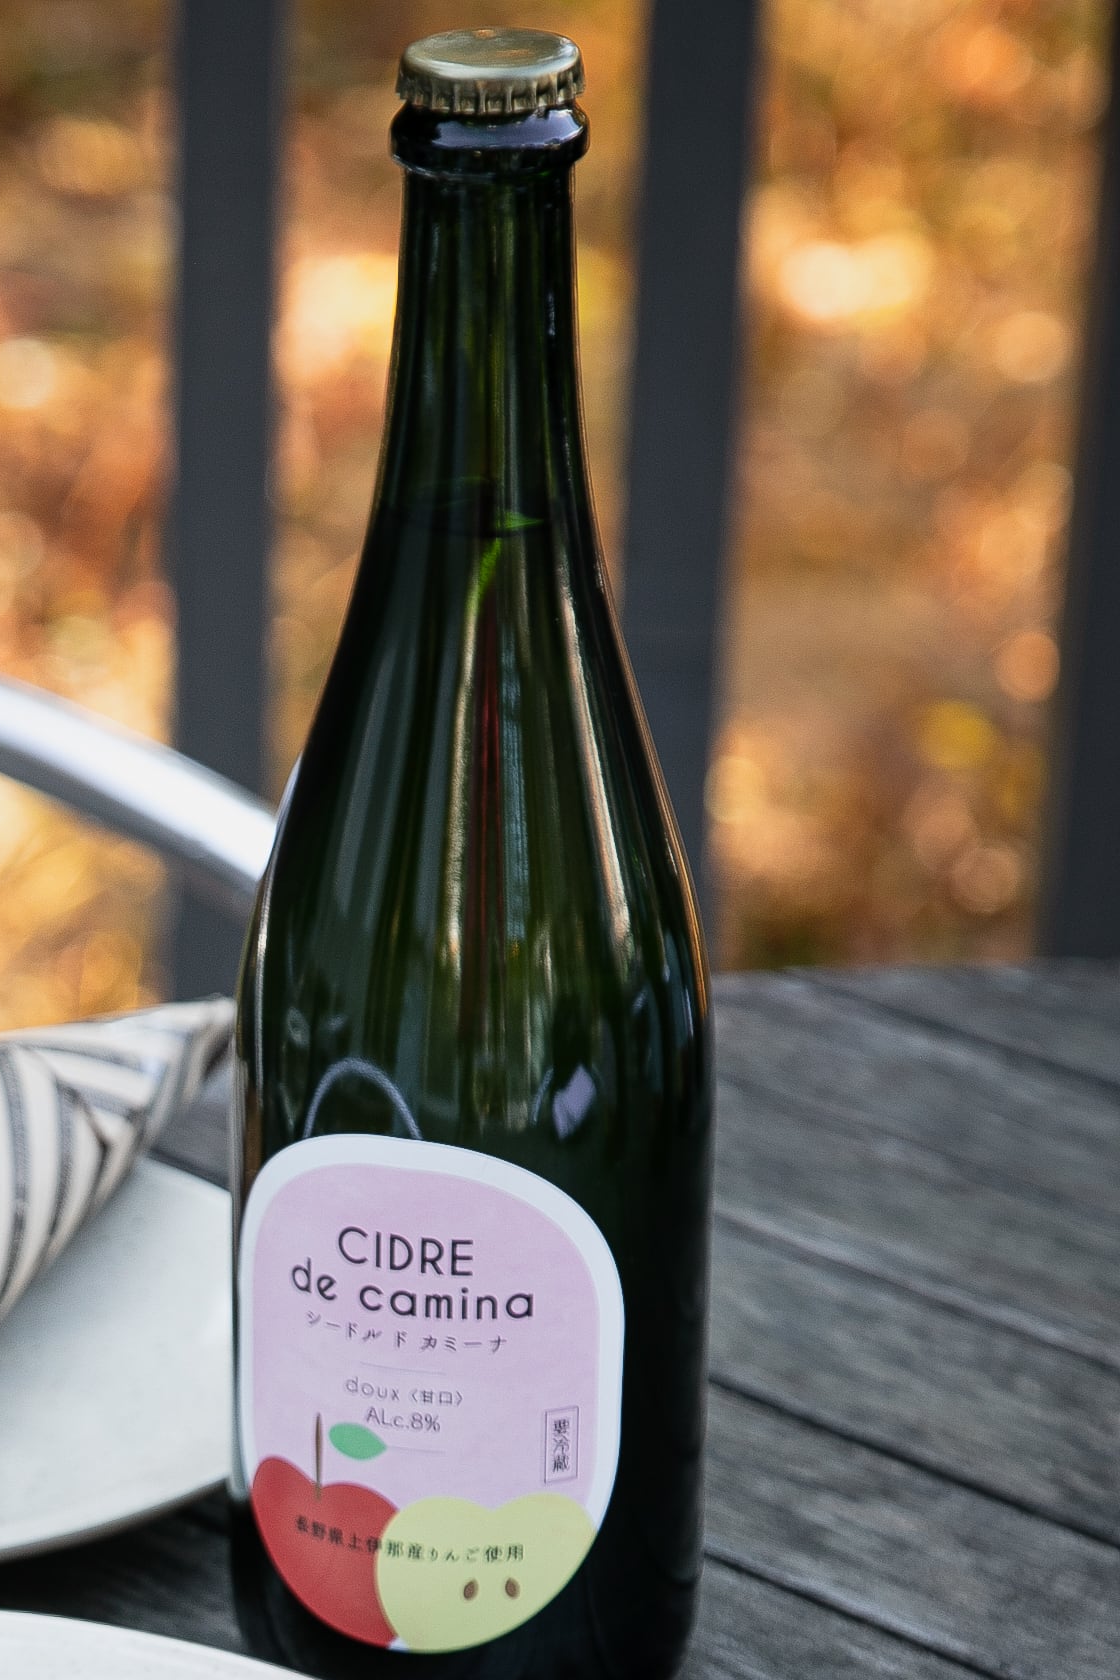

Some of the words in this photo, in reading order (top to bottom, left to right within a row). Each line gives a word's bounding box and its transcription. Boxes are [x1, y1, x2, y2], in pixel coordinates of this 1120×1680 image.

[337, 1226, 475, 1277] CIDRE
[291, 1257, 338, 1301] de
[359, 1283, 535, 1321] camina
[345, 1376, 400, 1401] doux
